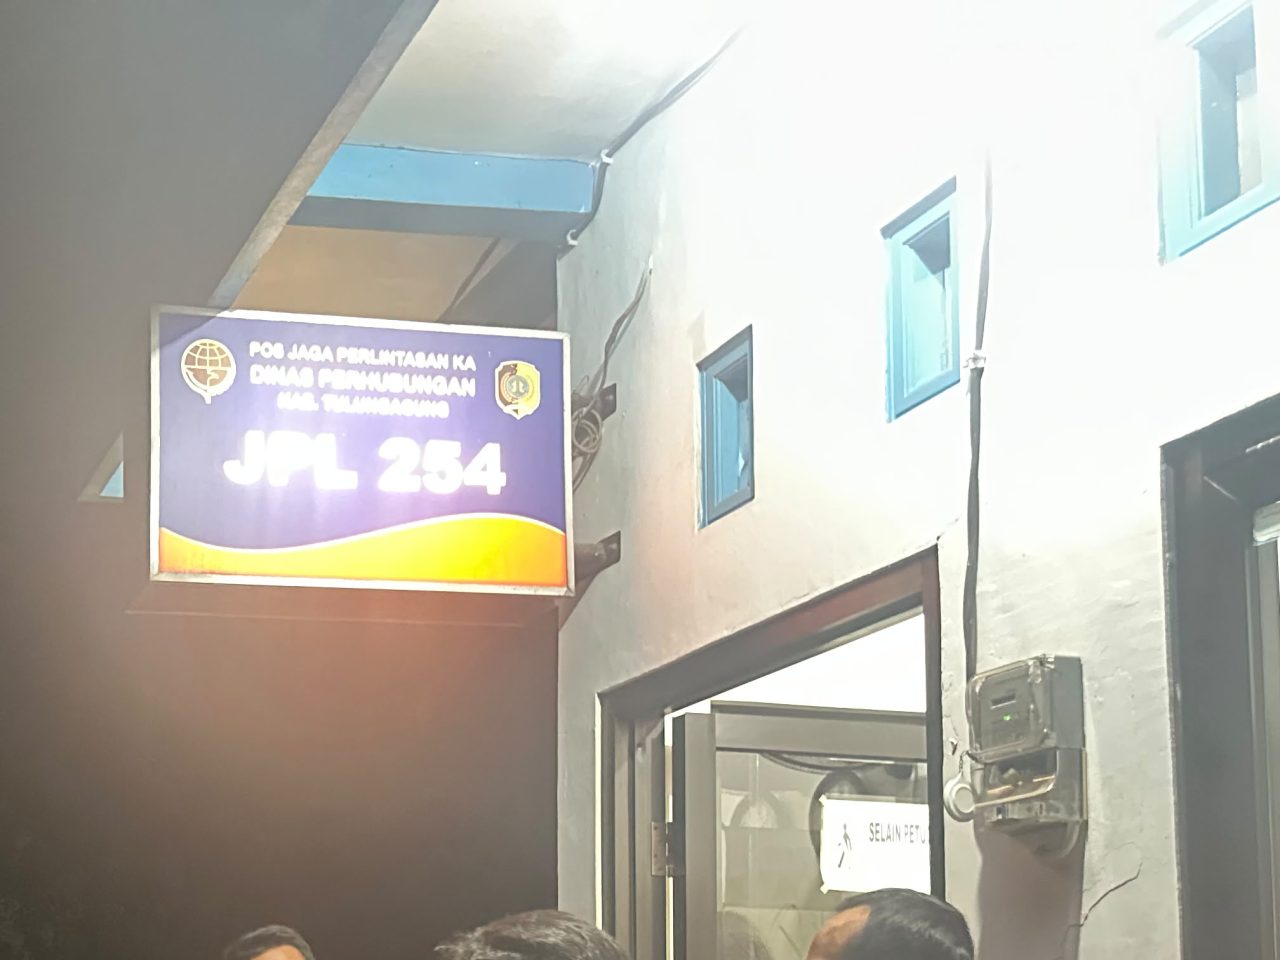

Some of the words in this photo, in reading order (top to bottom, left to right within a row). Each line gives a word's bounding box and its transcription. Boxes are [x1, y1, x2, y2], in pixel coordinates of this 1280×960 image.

[249, 341, 284, 359] POS
[287, 343, 333, 363] JAGA
[336, 346, 449, 370] PERLINTASAN
[452, 354, 477, 371] KA
[249, 364, 314, 388] DINAS
[318, 368, 476, 397] PERHUBUNGAN
[223, 429, 358, 490] JPL
[377, 436, 507, 495] 254
[869, 822, 901, 842] SELAIN
